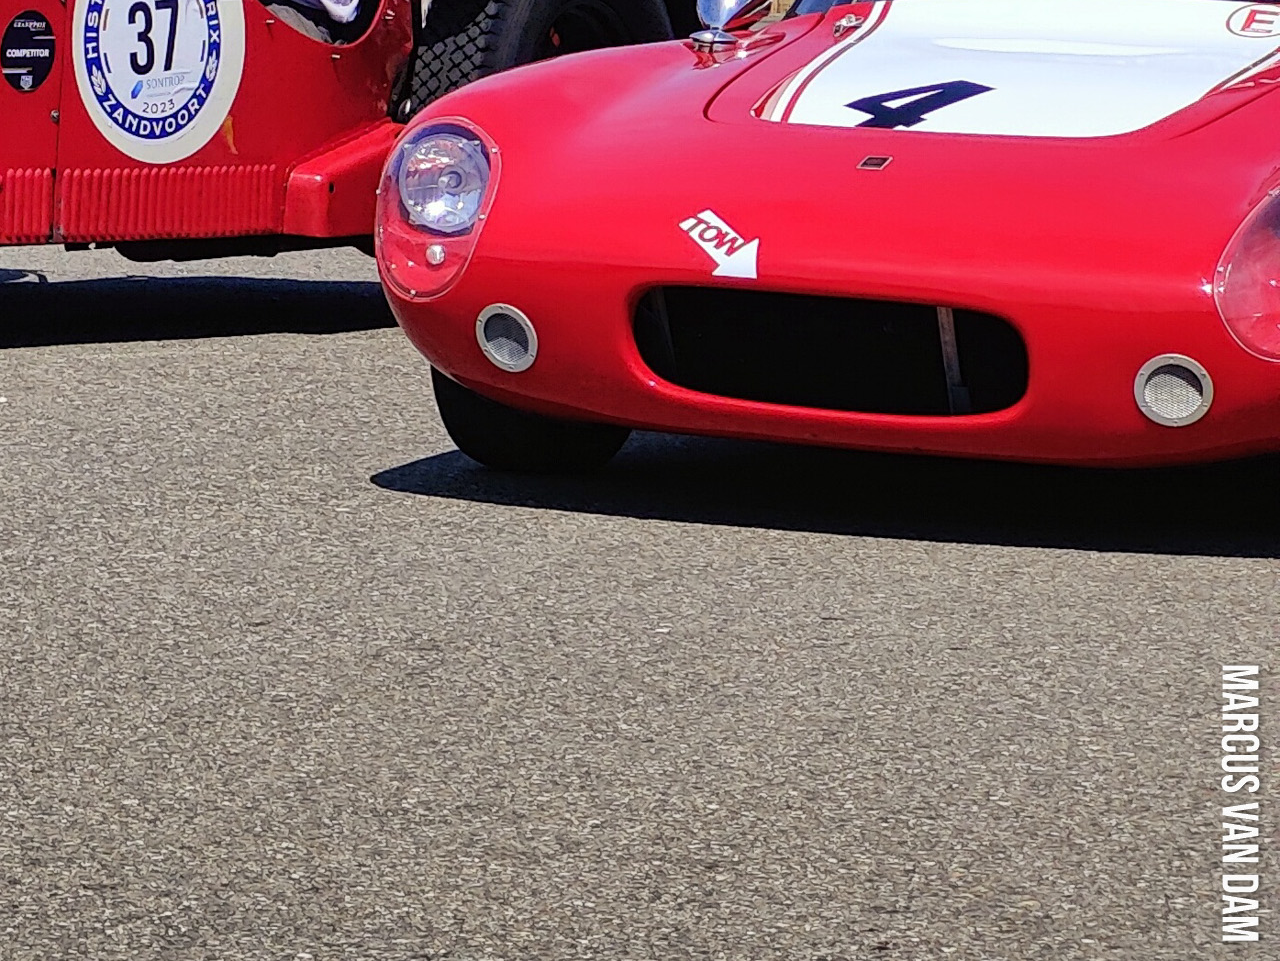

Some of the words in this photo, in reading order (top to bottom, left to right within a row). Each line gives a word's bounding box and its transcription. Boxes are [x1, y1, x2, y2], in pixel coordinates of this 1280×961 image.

[6, 48, 50, 58] COMPETITOR
[102, 84, 207, 136] ZANDVOORT
[142, 99, 176, 114] 2023
[843, 80, 997, 129] 4
[685, 216, 746, 257] TOW
